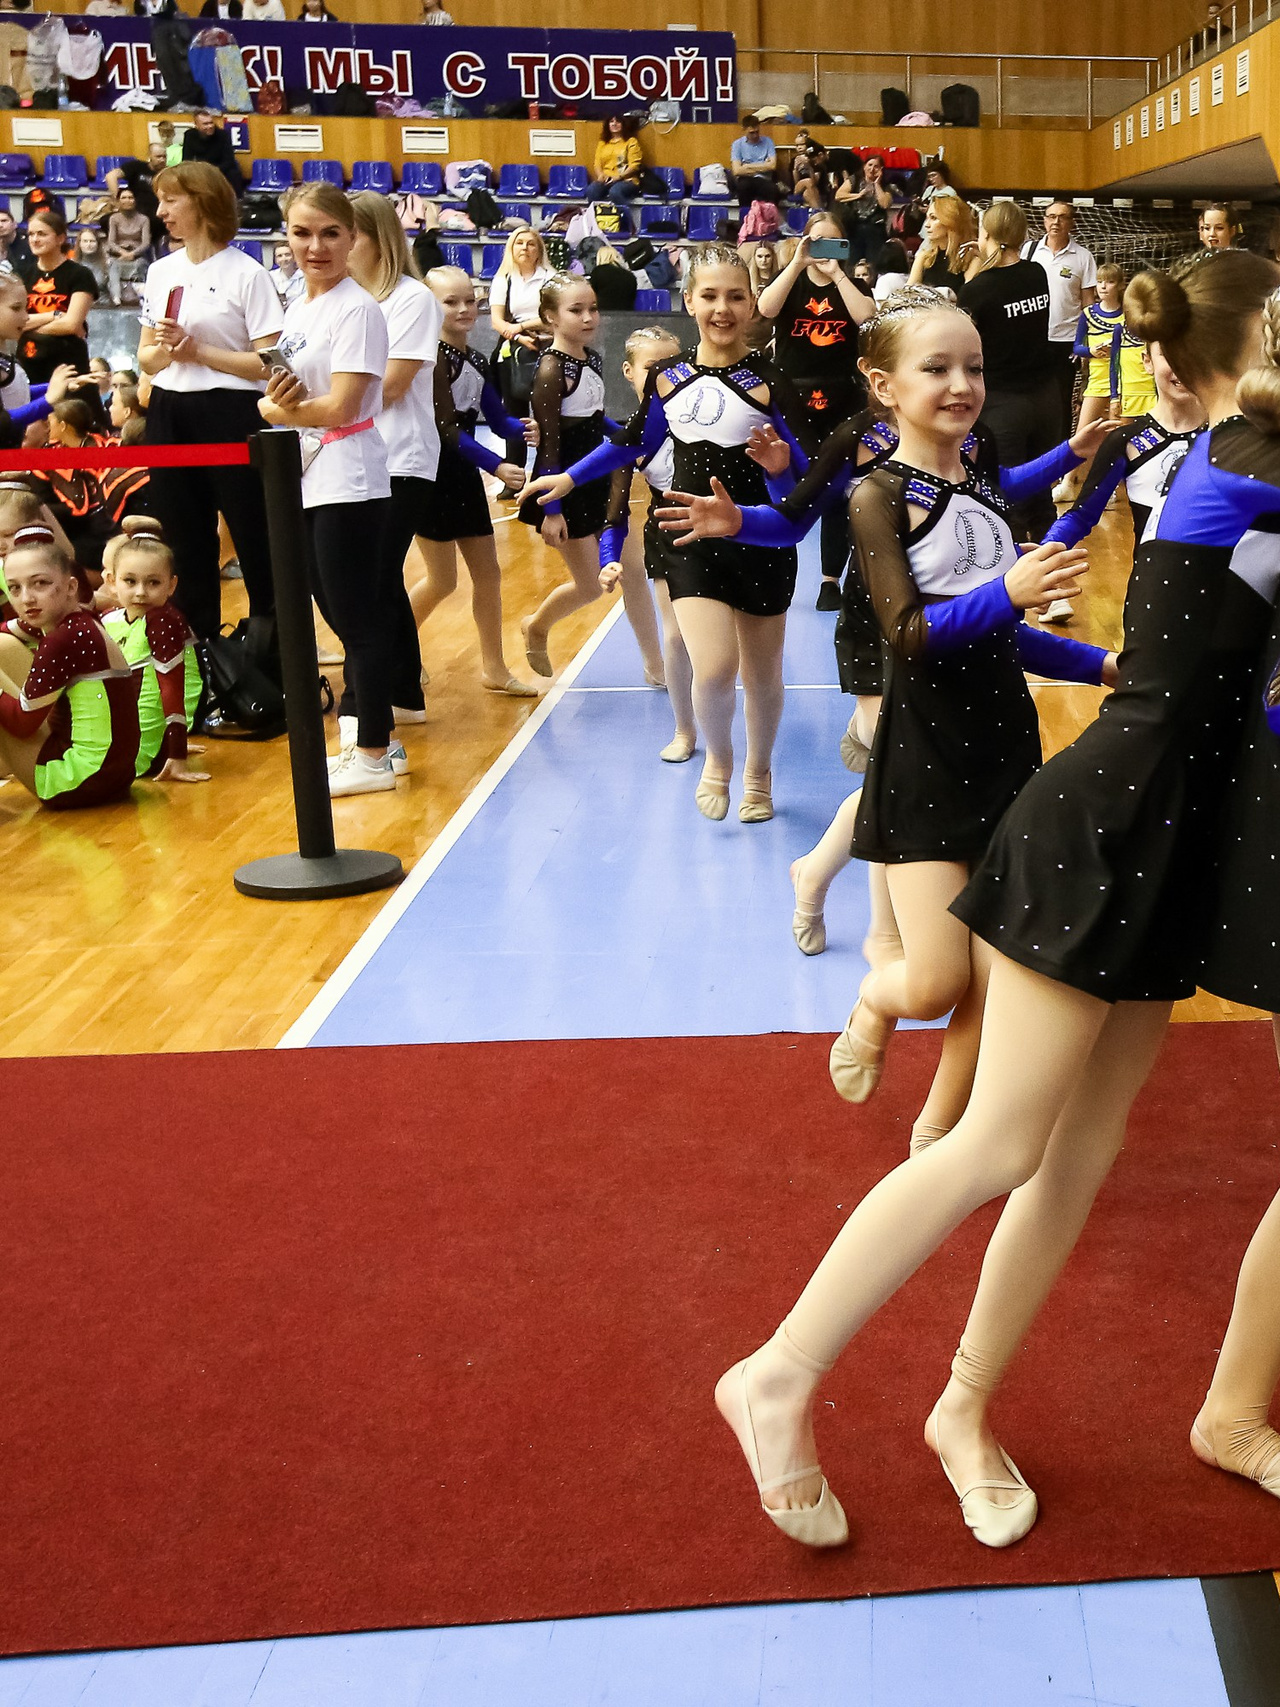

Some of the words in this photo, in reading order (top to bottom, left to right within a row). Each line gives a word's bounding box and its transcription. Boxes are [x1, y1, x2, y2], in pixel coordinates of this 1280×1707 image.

[304, 46, 413, 96] МЫ
[443, 51, 487, 98] С
[508, 47, 734, 102] ТОБОЙ!
[1003, 293, 1049, 318] ТРЕНЕР
